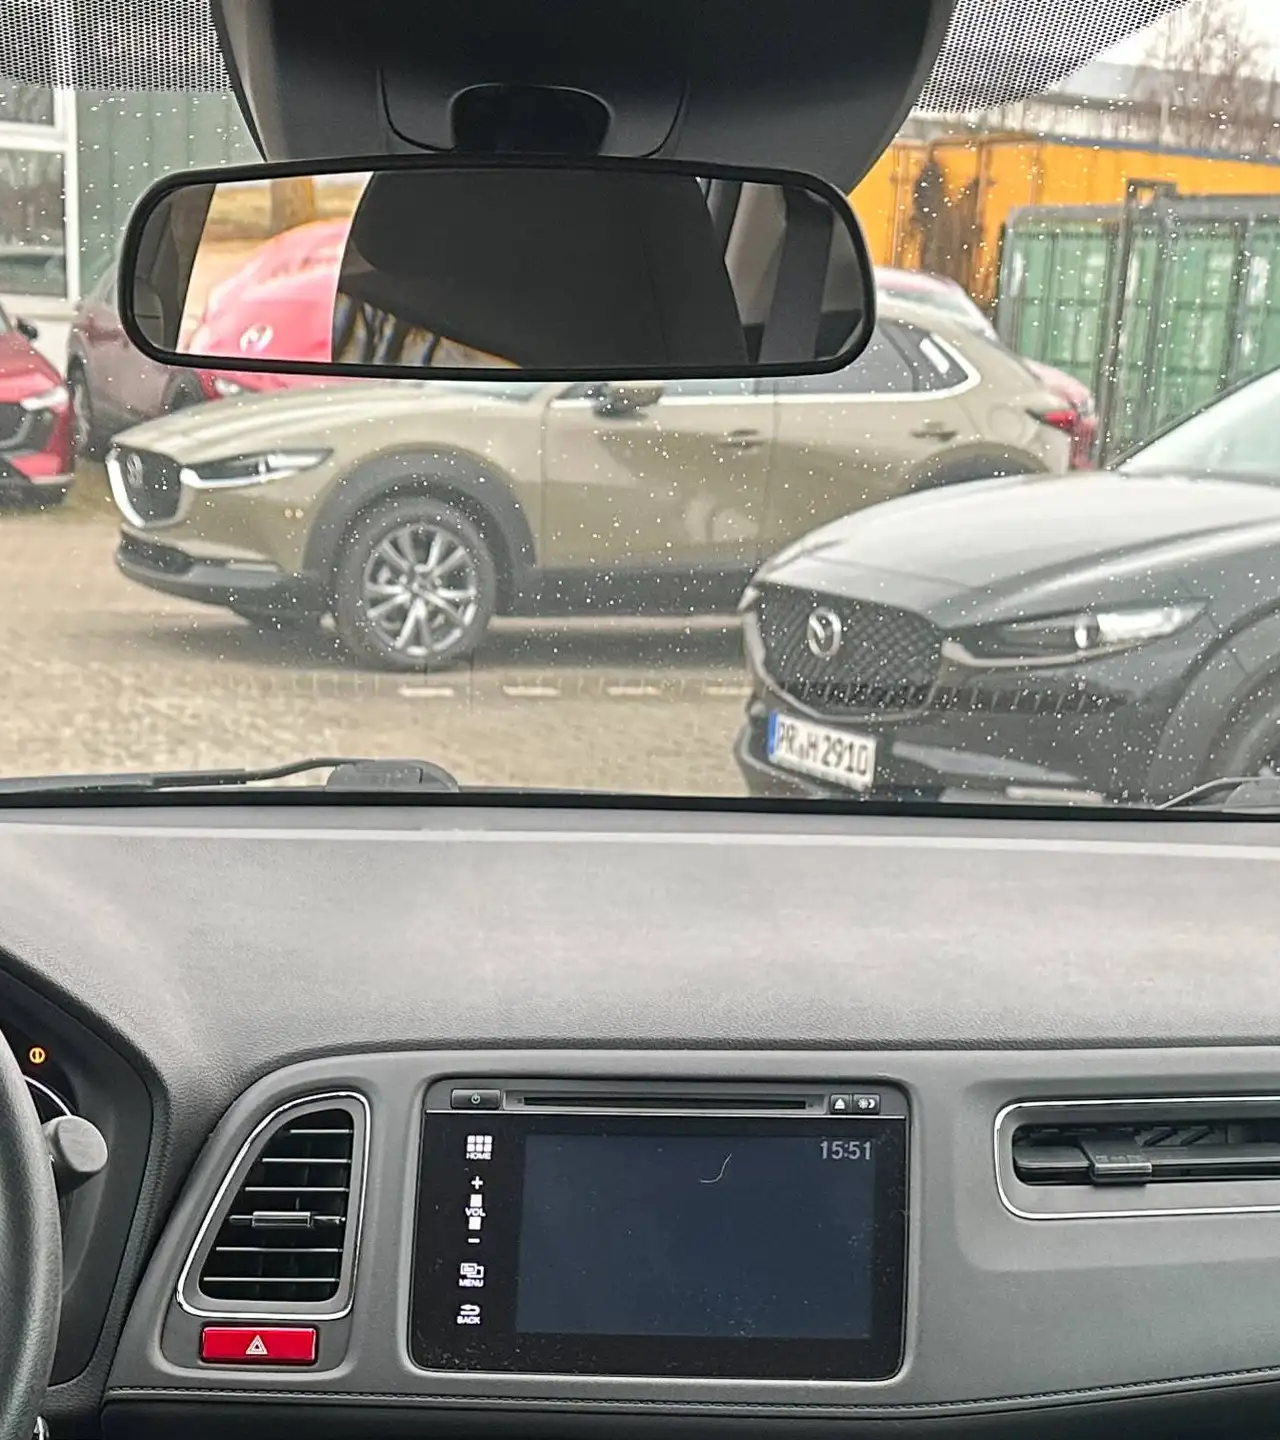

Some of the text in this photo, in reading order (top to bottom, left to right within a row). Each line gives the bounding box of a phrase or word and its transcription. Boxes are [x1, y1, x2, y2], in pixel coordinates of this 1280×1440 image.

[820, 1141, 871, 1160] 15:51
[465, 1207, 486, 1217] VOL
[458, 1278, 484, 1288] MENU
[457, 1315, 481, 1325] BACK
